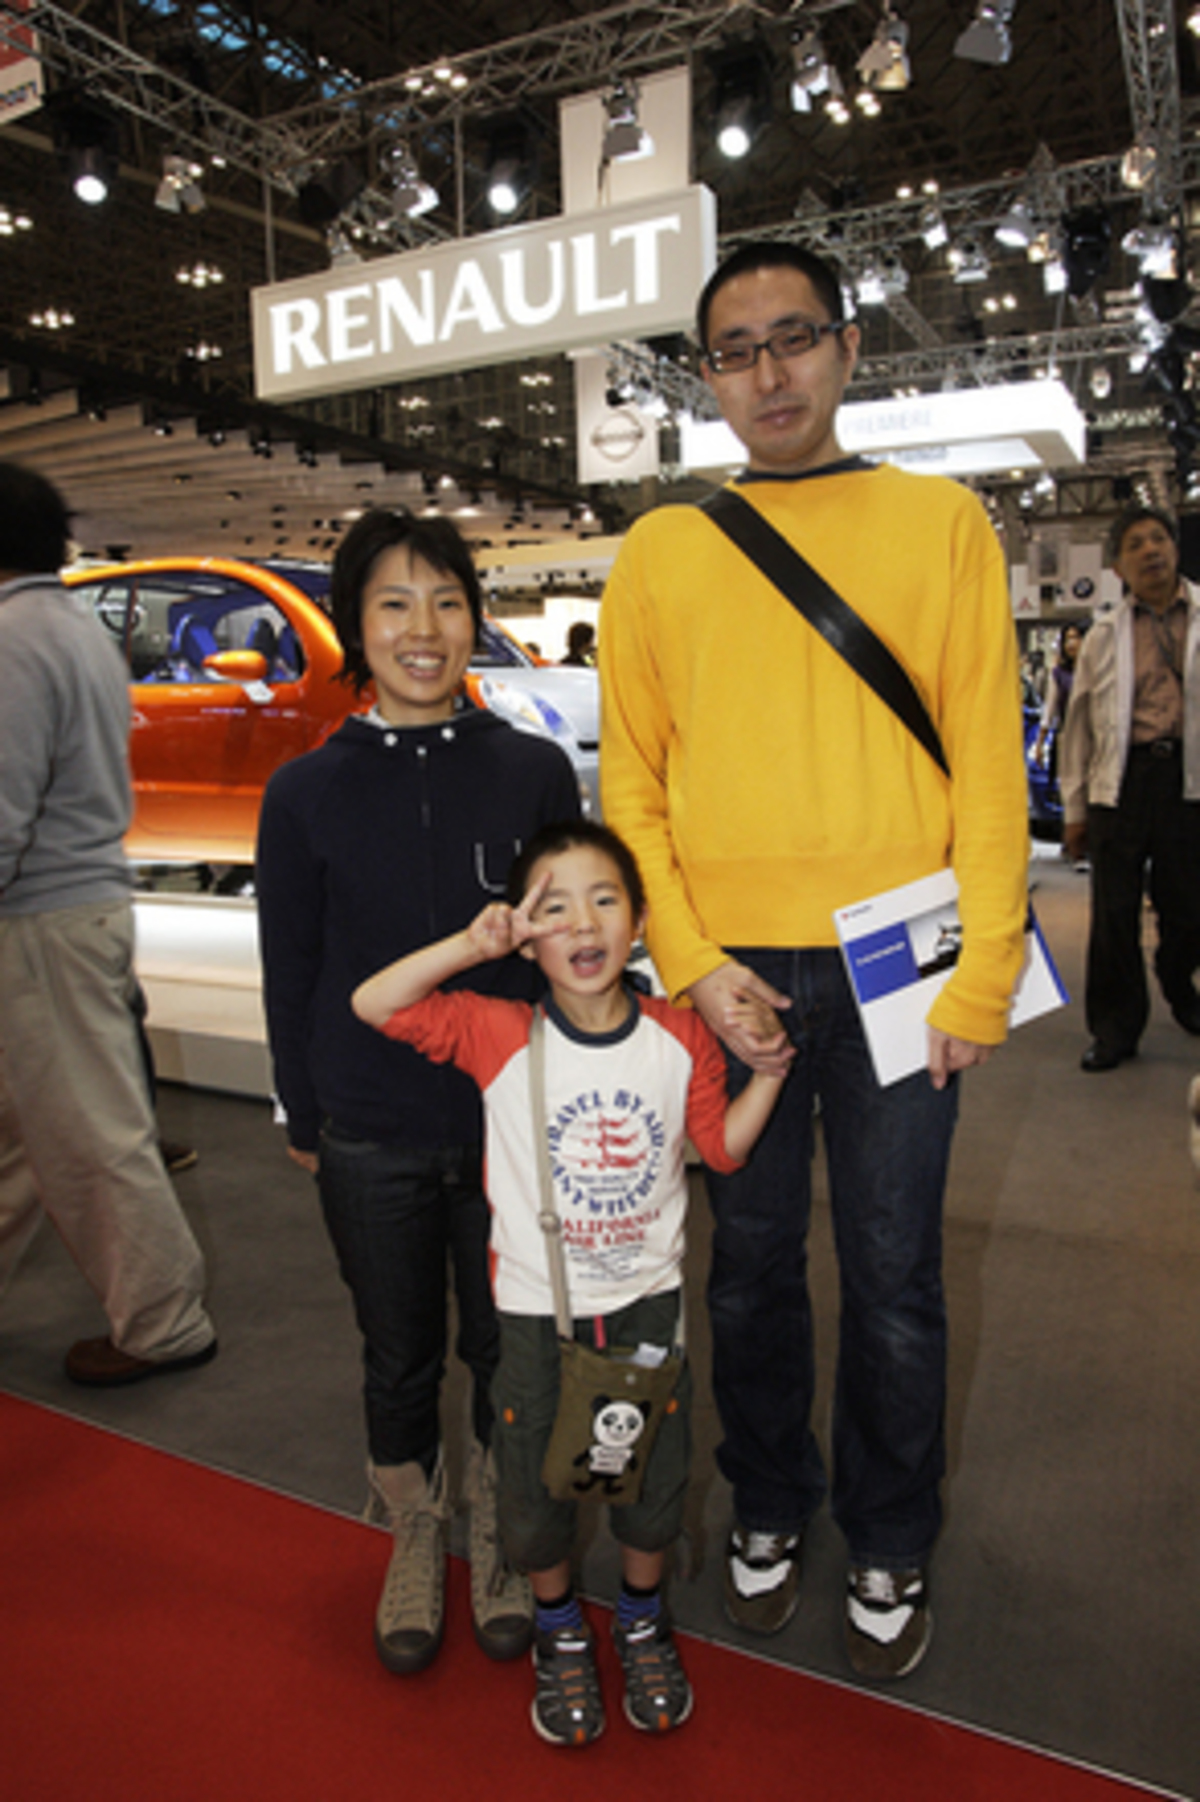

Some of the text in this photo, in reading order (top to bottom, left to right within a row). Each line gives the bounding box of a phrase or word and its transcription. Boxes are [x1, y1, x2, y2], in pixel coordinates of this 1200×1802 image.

[269, 214, 681, 375] RENAULT
[613, 1088, 643, 1114] BY
[563, 1208, 660, 1234] ALIFORNIA
